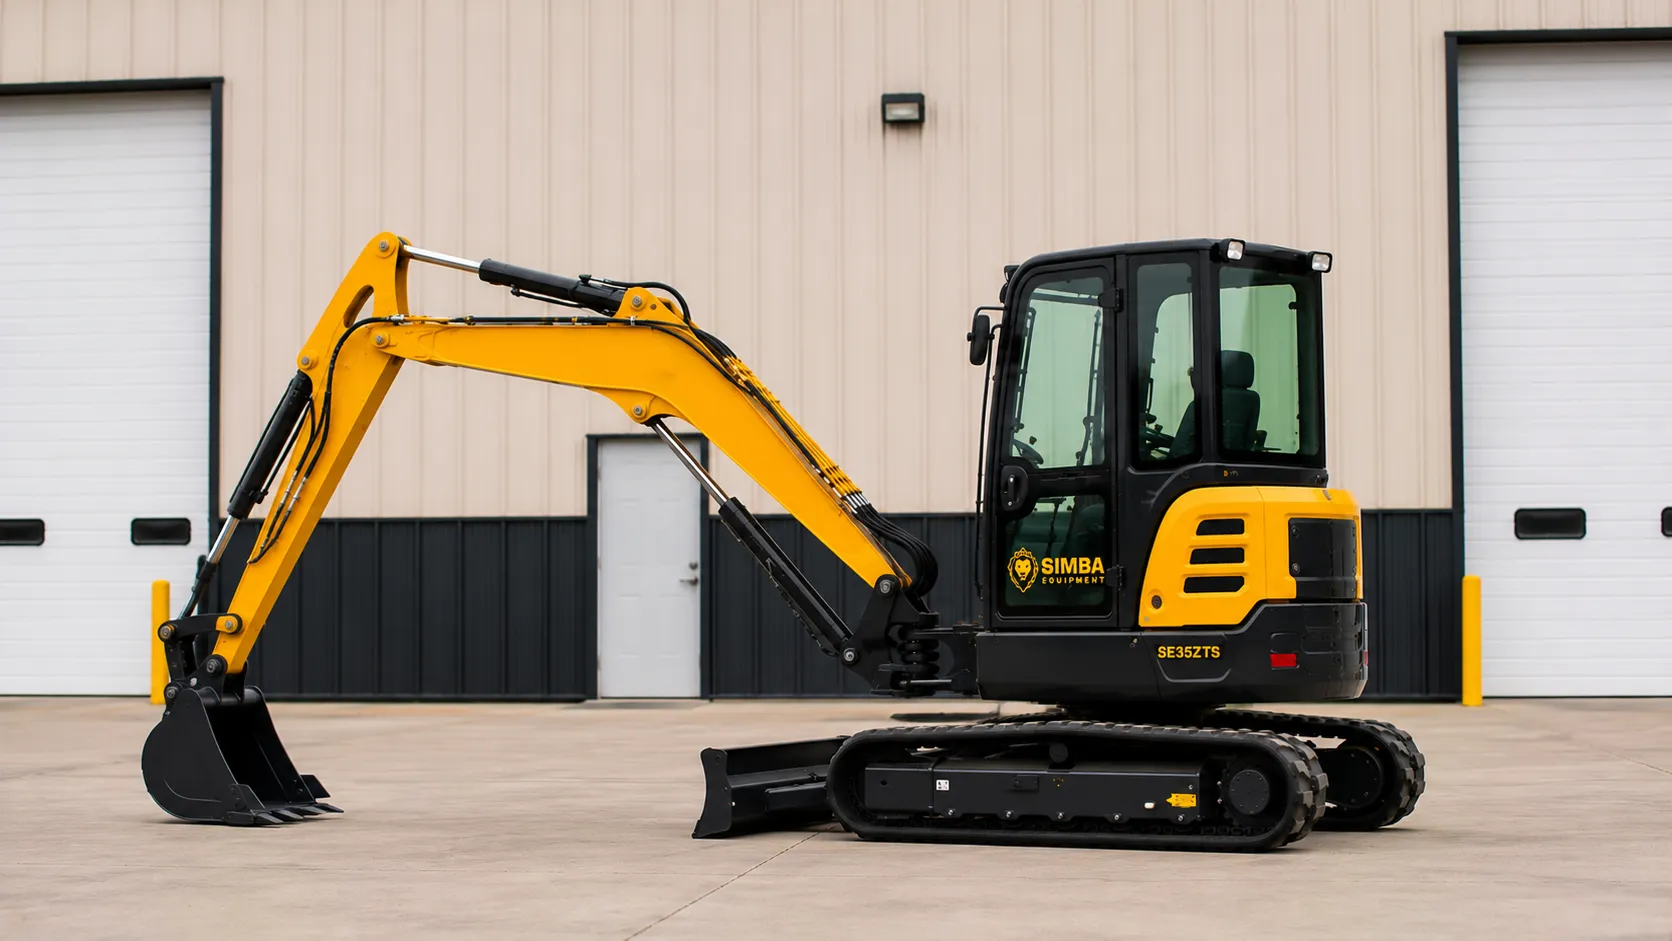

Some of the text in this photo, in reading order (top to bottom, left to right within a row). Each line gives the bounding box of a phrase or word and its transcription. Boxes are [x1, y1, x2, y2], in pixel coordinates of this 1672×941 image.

[1041, 557, 1105, 575] SIMBA
[1041, 576, 1105, 585] EQUIPMENT
[1157, 645, 1221, 659] SE35ZTS
